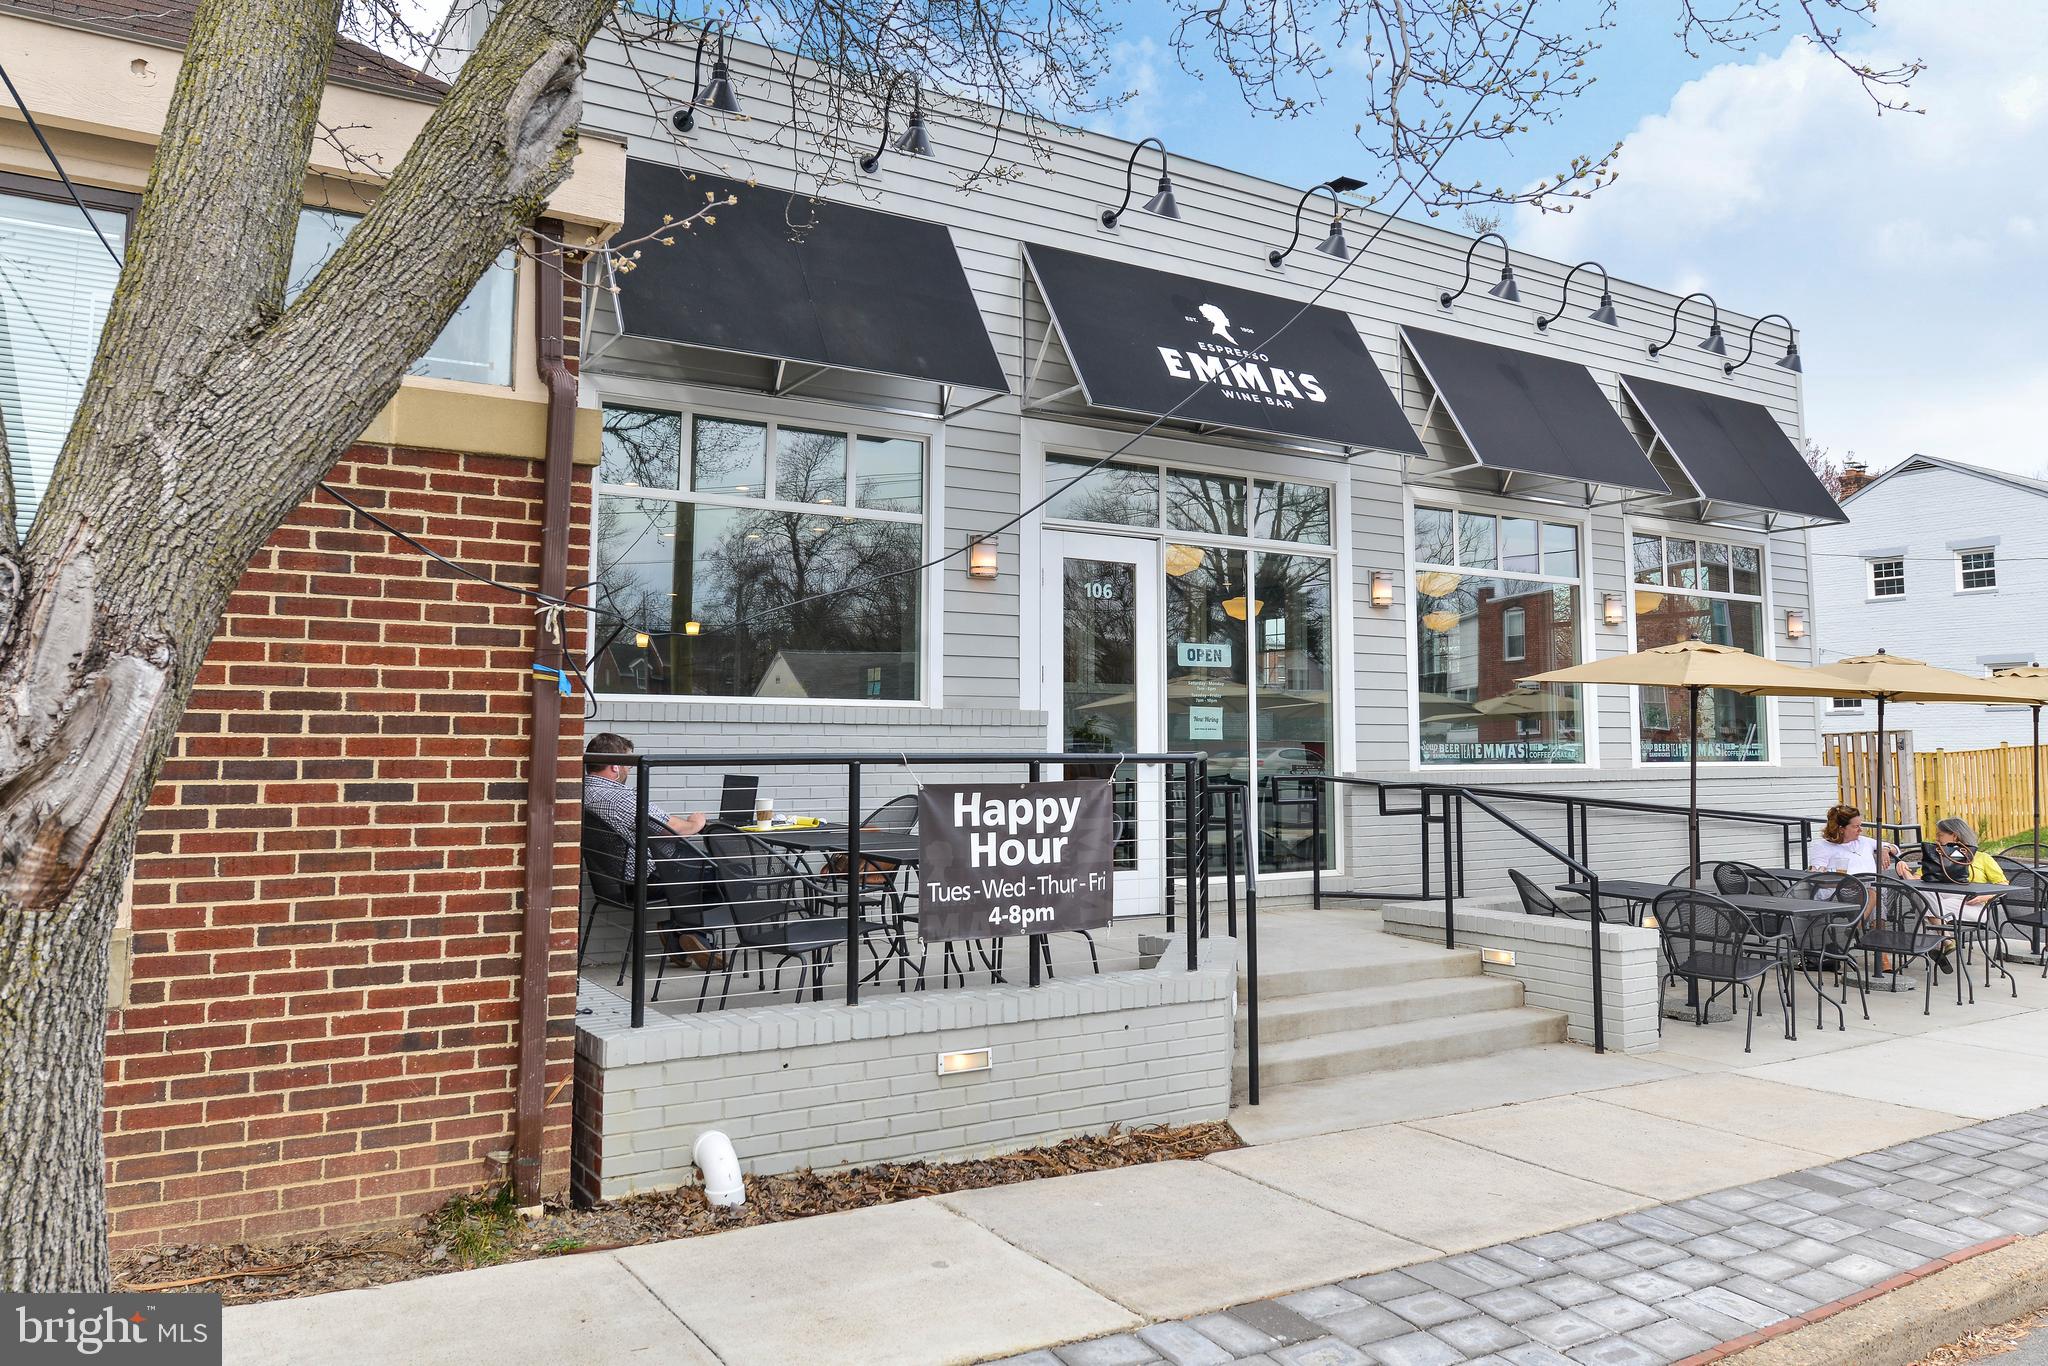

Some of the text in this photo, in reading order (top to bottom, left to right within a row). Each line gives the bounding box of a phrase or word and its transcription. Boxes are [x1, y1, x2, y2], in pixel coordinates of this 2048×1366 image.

[1197, 341, 1269, 362] ESPRESSO
[1156, 346, 1328, 403] EMMA'S
[1221, 388, 1294, 410] WINE BAR
[1084, 582, 1113, 600] 106
[1187, 648, 1222, 662] OPEN
[1439, 743, 1460, 753] BEER
[1475, 743, 1525, 759] EMMA'S
[1529, 751, 1551, 759] COFFEE
[1653, 743, 1670, 752] BEER
[1681, 743, 1721, 757] EMA'S
[953, 792, 1082, 836] Happy
[970, 831, 1069, 868] Hour
[988, 904, 1055, 928] 4-8pm
